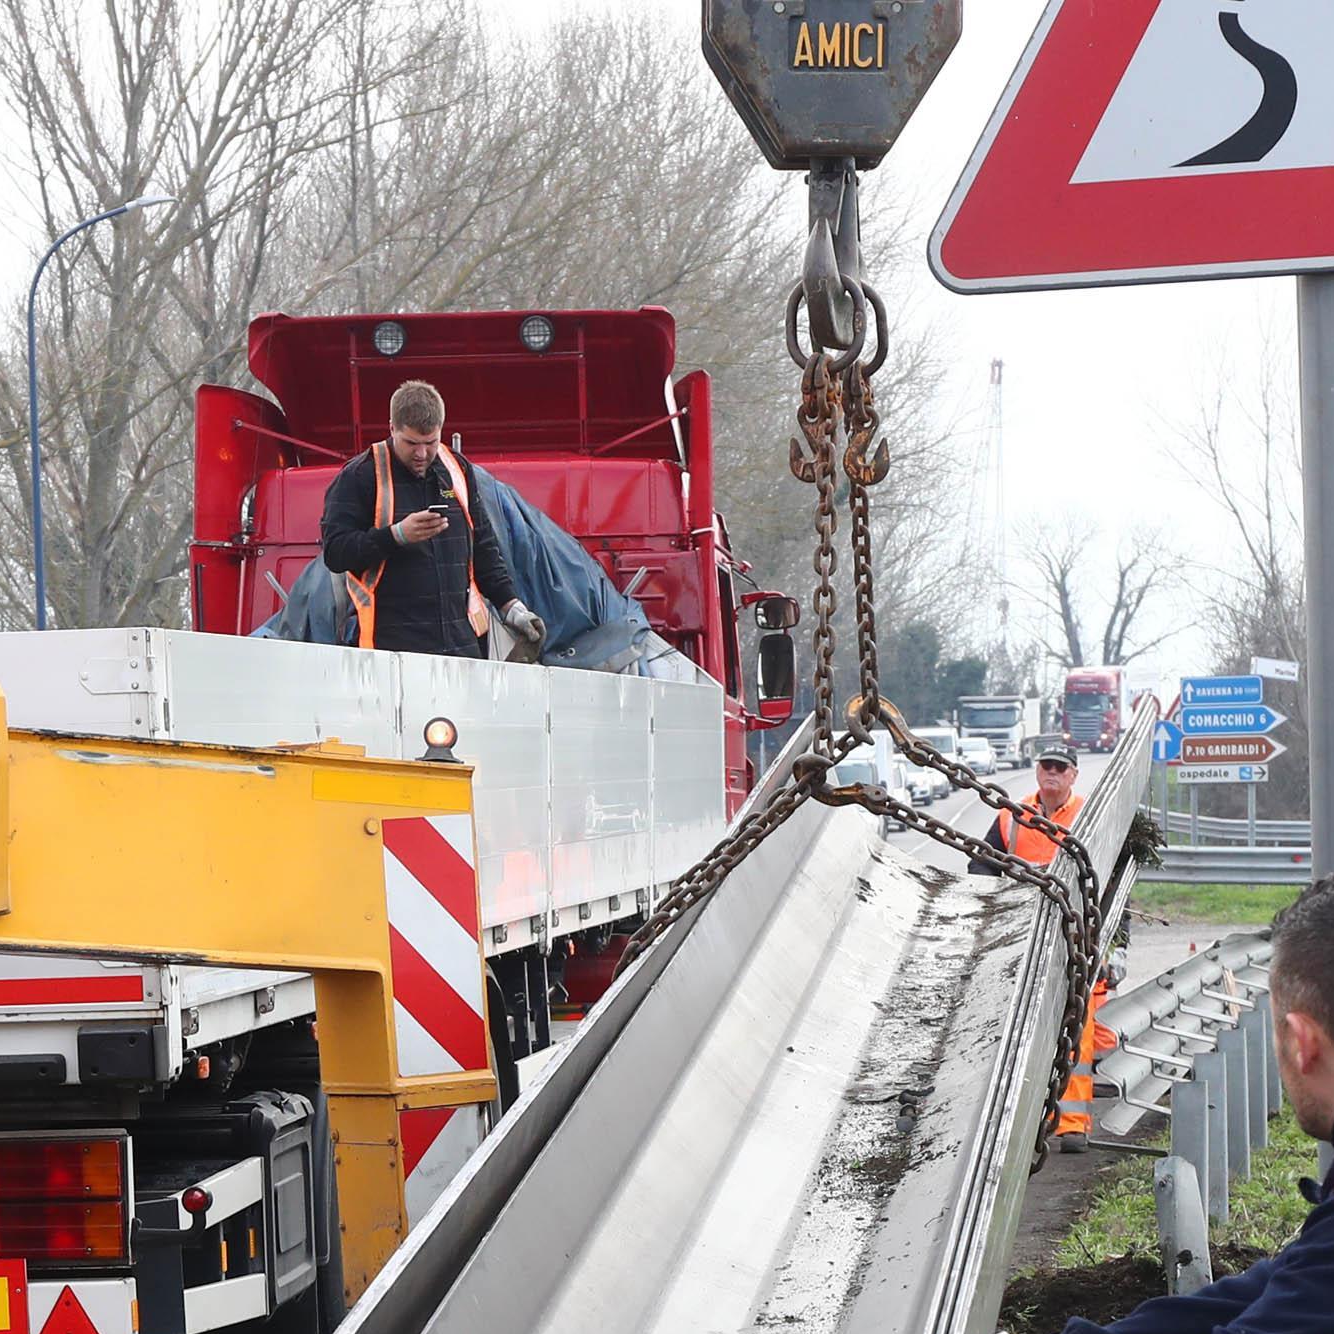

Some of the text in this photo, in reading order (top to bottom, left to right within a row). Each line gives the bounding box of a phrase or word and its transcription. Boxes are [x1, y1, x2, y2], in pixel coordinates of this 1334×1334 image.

[793, 21, 885, 69] AMICI
[1196, 686, 1233, 697] RAVENNA
[1188, 713, 1267, 727] COMACCHIO 6
[1208, 743, 1259, 756] GARIBALDI
[1262, 745, 1267, 755] 1
[1179, 768, 1230, 781] ospedale
